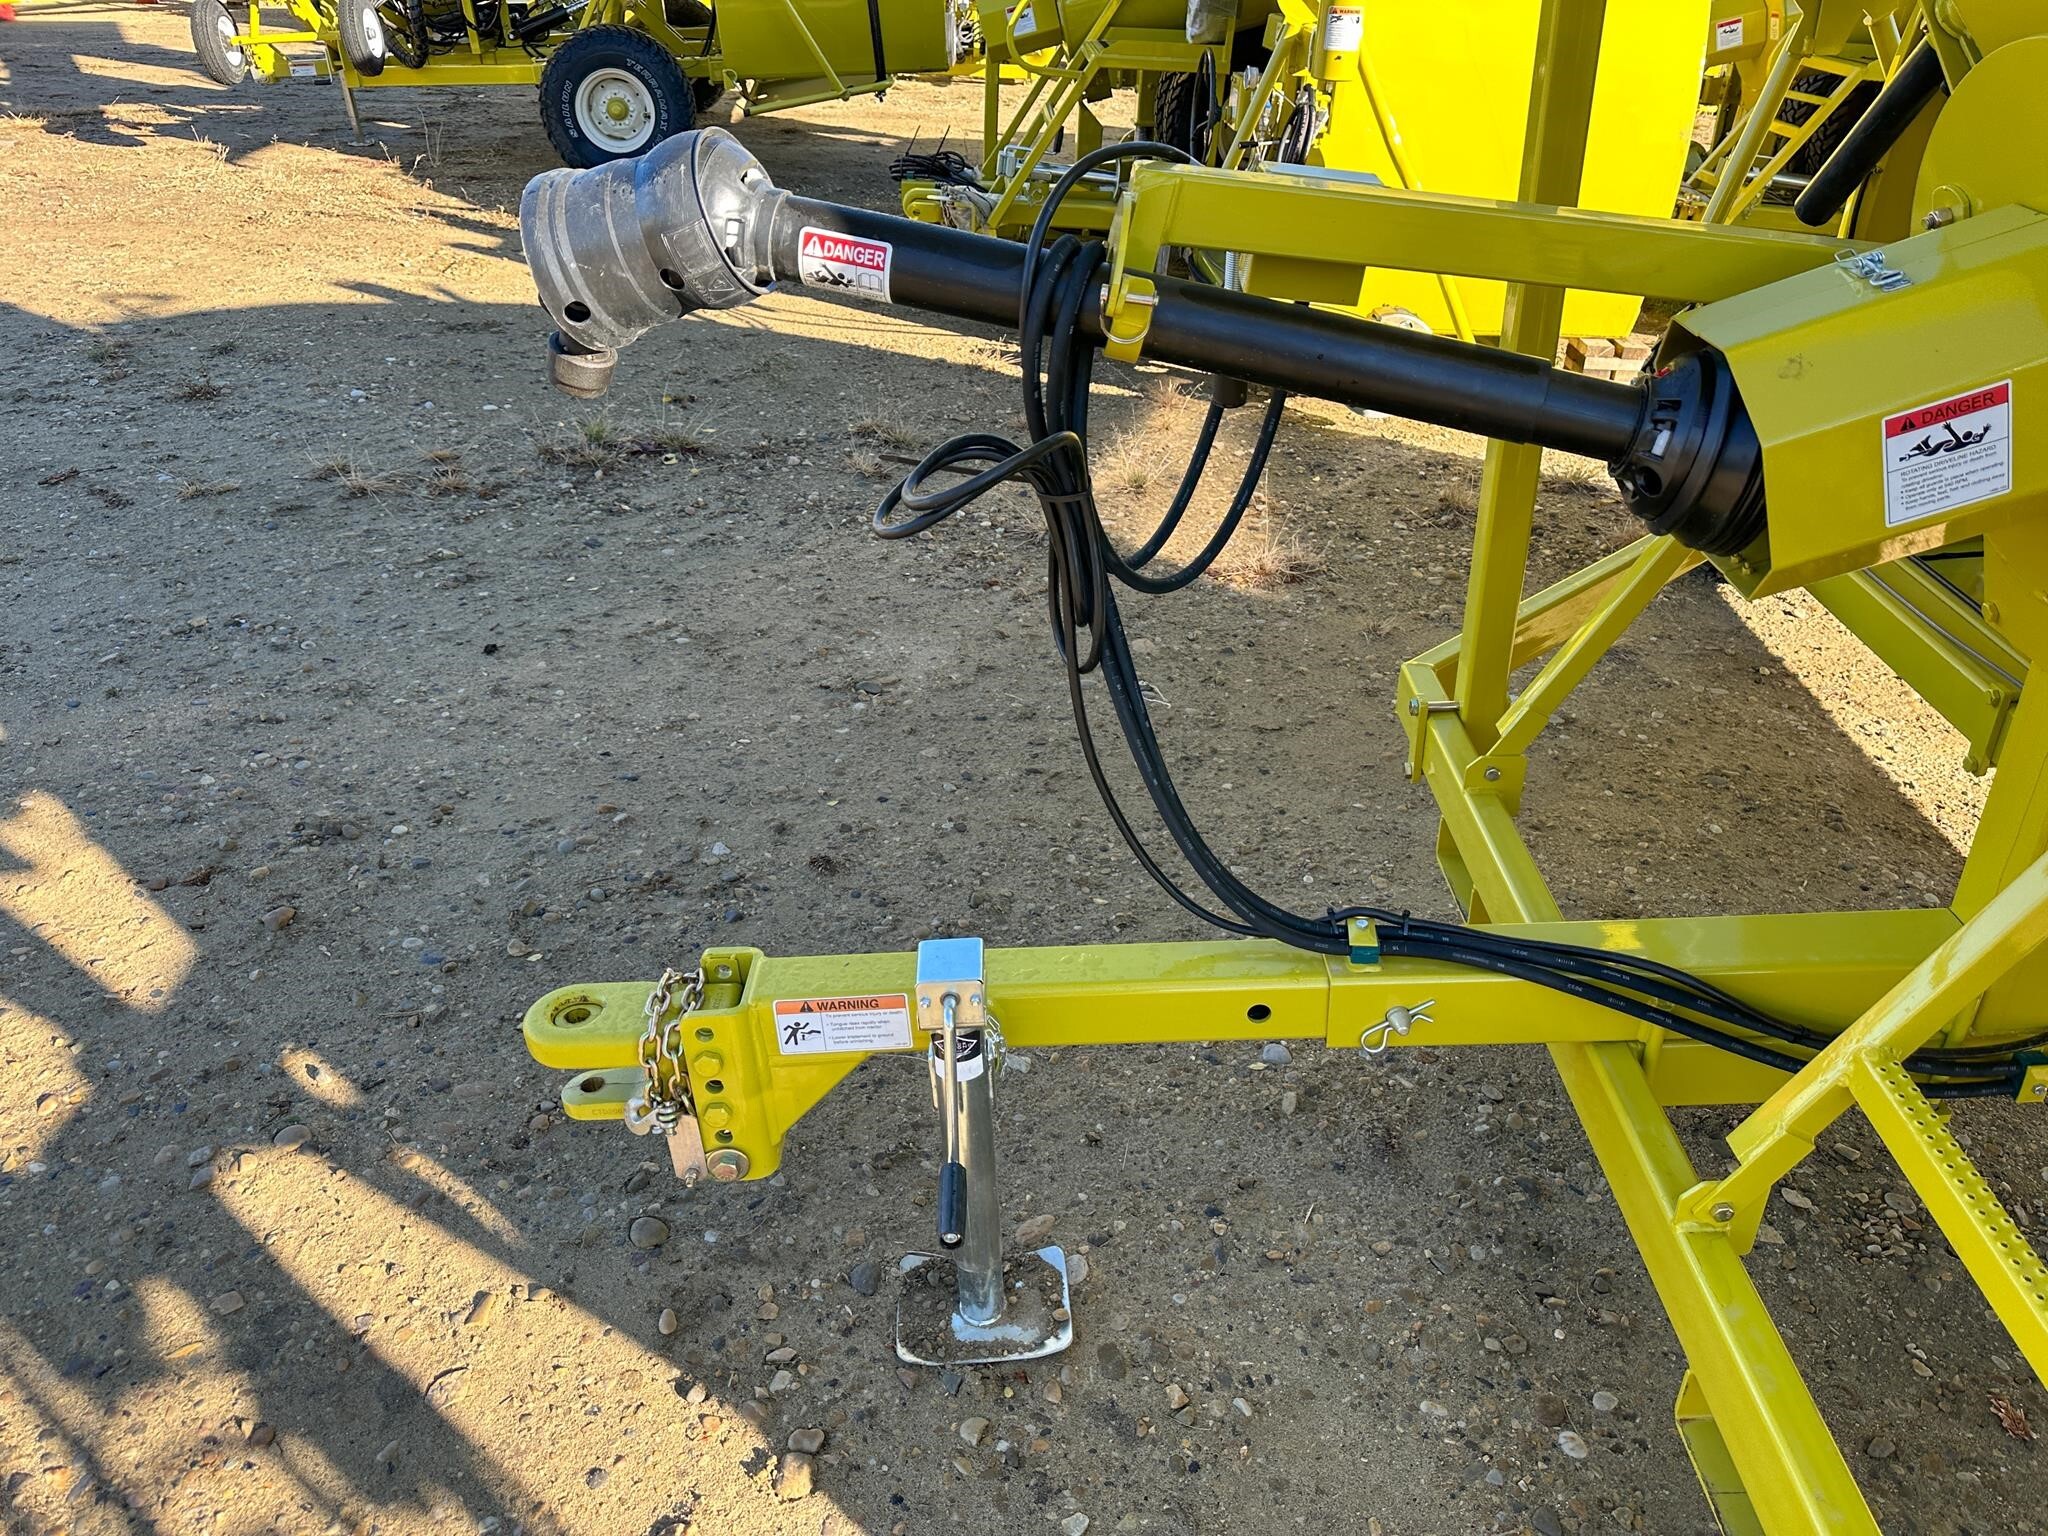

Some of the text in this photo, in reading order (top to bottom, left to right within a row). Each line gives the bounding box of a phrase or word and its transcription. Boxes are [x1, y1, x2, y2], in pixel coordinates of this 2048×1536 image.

[558, 80, 579, 139] SAILUN
[625, 57, 669, 132] TERRAMAX
[823, 240, 885, 268] DANGER
[1921, 391, 1996, 425] DANGER
[1900, 444, 1996, 477] ROTATING DRIVELINE HAZARD
[816, 998, 880, 1011] WARNING
